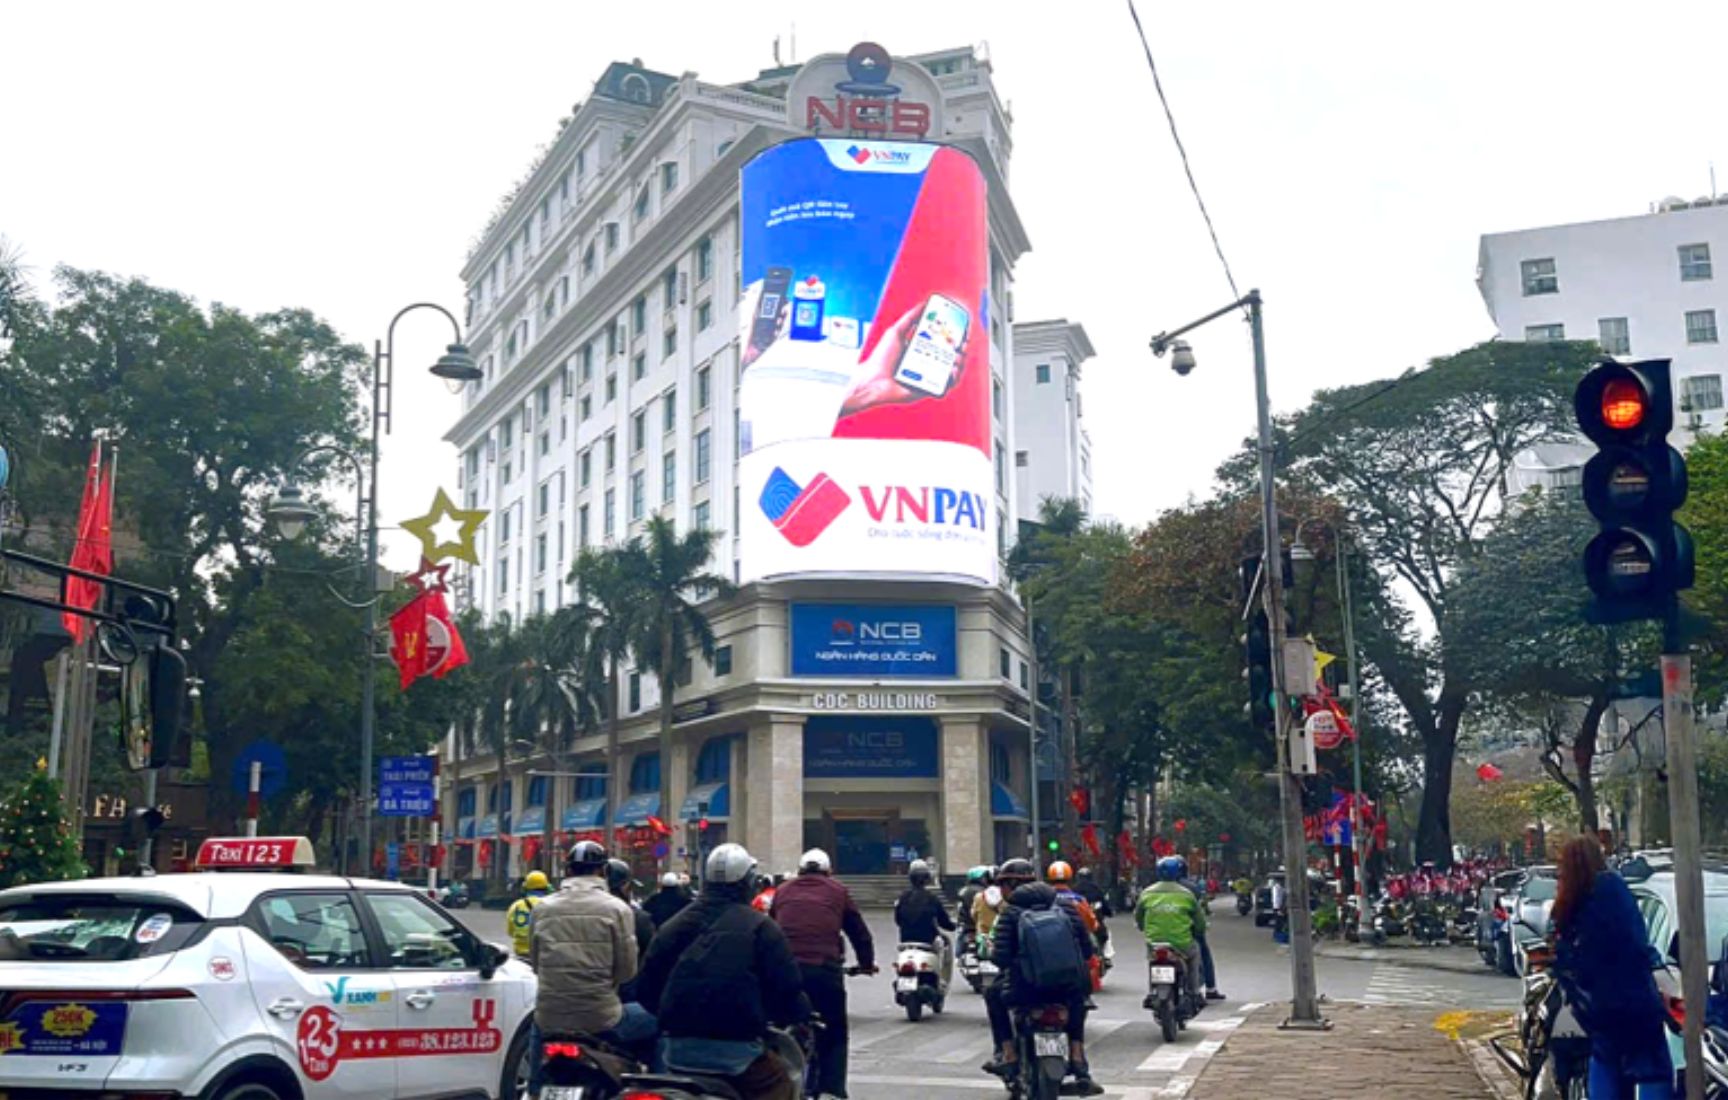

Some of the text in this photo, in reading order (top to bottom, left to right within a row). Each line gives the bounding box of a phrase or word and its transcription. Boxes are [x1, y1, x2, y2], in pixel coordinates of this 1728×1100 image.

[806, 95, 931, 136] NCB
[858, 486, 987, 532] VNPAY
[860, 621, 921, 639] NCB
[812, 693, 937, 709] CDC BUILDING
[848, 731, 904, 747] NCB
[210, 844, 283, 862] Taxi 123
